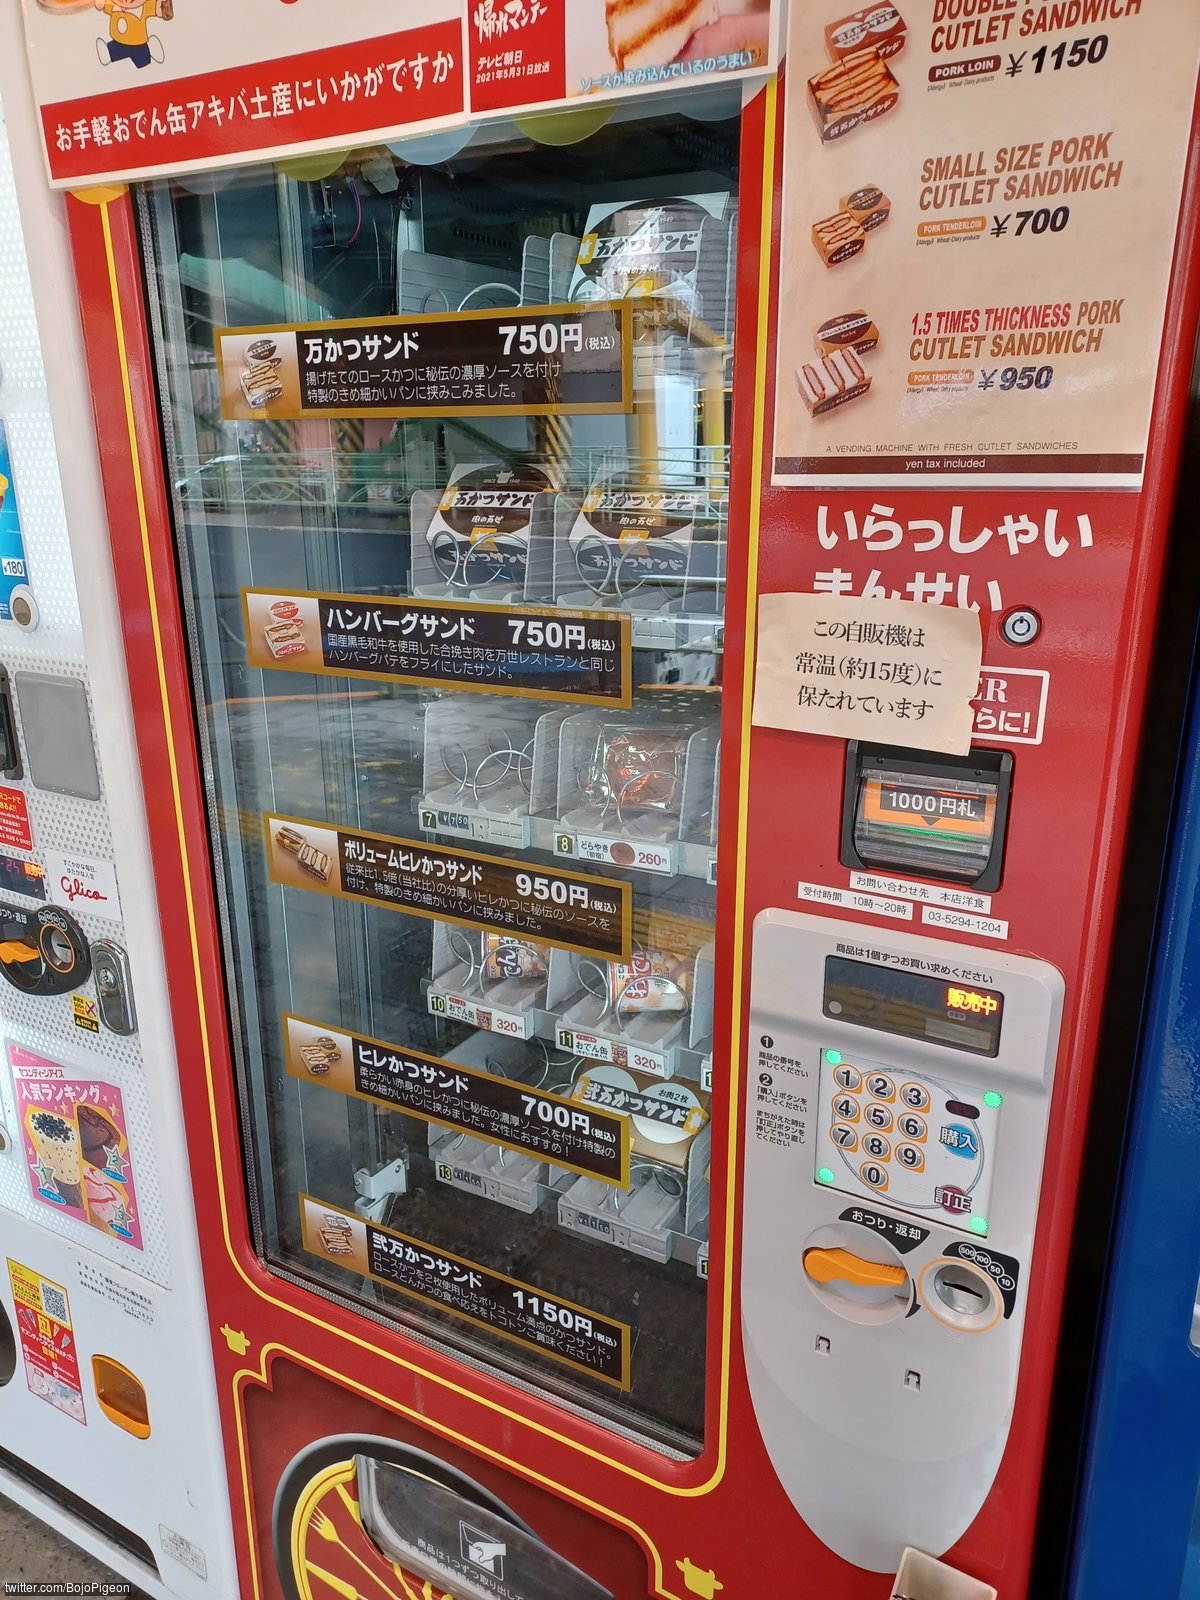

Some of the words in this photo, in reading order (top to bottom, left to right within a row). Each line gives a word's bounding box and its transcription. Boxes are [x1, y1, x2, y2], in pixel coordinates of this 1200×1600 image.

[931, 13, 1016, 53] CUTLET
[1019, 0, 1143, 37] SANDWICH
[477, 50, 523, 71] テレビ朝日
[936, 66, 965, 79] PORK
[968, 59, 995, 74] LOIN
[1005, 34, 1109, 78] ¥1150
[476, 62, 550, 83] 2021年5月31日放送
[56, 51, 454, 152] お手軽おでん缶アキバ土産にいかがですか
[920, 151, 987, 184] SMALL
[994, 141, 1042, 174] SIZE
[1047, 131, 1114, 165] PORK
[919, 178, 998, 211] CUTLET
[1004, 160, 1124, 201] SANDWICH
[923, 225, 941, 234] PORK
[942, 220, 982, 232] TENDERLOIN
[990, 206, 1070, 238] ¥700
[911, 312, 932, 337] 1.5
[935, 309, 979, 335] TIMES
[985, 302, 1072, 332] THICKNESS
[1077, 299, 1125, 326] PORK
[303, 331, 420, 364] 万かつサンド
[909, 336, 986, 362] CUTLET
[989, 328, 1104, 357] SANDWICH
[305, 362, 562, 387] 揚げたてのロースかつに秘伝の濃厚ソースを付け
[914, 374, 931, 382] PORK
[307, 382, 517, 403] 特製のきめ細かいパンに挟みこみました。
[836, 444, 872, 453] VENDING
[876, 443, 913, 453] MACHINE
[918, 443, 940, 452] WITH
[944, 442, 973, 452] FRESH
[977, 442, 1011, 451] CUTLET
[1016, 441, 1078, 451] SANDWICHES
[905, 459, 924, 471] yen
[926, 459, 941, 470] tax
[943, 457, 986, 470] included
[816, 502, 1094, 558] いらっしゃい
[327, 607, 475, 642] ハンバーグサンド
[813, 619, 926, 648] この自販機は
[328, 633, 615, 672] 国産黒毛和牛を使用した合挽き肉を万世レストランと同じ
[329, 650, 514, 681] ハンバーグパテをフライにしたサンド。
[795, 651, 943, 687] 常温(約15度)に
[796, 685, 935, 721] 保たれています
[889, 791, 976, 817] 1000円札
[561, 836, 570, 852] 8
[581, 840, 609, 853] どらやき
[344, 839, 483, 886] ボリュームヒレかつサンド
[60, 875, 108, 902] Glico
[803, 886, 842, 903] 受付時間
[856, 876, 929, 899] お問い合わせ先
[940, 892, 985, 909] 本店洋食
[928, 911, 1002, 934] 03-5294-1204
[836, 943, 993, 984] 商品は1個ずつお買い求めください
[431, 997, 444, 1012] 10
[946, 987, 998, 1016] 販売中
[560, 1032, 573, 1048] 11
[575, 1041, 608, 1055] おでん缶
[357, 1044, 469, 1093] ヒレかつサンド
[758, 1050, 802, 1069] 商品の番号を
[758, 1059, 809, 1078] 押してください
[842, 1069, 851, 1087] 1
[874, 1077, 888, 1097] 2
[21, 1081, 100, 1104] 人気ランキング
[757, 1094, 808, 1113] 押してください
[908, 1087, 922, 1106] 3
[359, 1066, 616, 1159] 柔らかい赤身のヒレかつに秘伝の濃厚ソースを付け特製の
[756, 1109, 806, 1129] まちがえた時は
[838, 1099, 851, 1116] 4
[871, 1108, 884, 1126] 5
[756, 1124, 806, 1144] 押してやり直し
[836, 1127, 850, 1146] 7
[904, 1117, 918, 1136] 6
[756, 1132, 791, 1148] てください
[869, 1137, 883, 1157] 8
[939, 1126, 979, 1155] 購入
[903, 1147, 917, 1166] 9
[440, 1166, 452, 1180] 13
[867, 1166, 880, 1186] 0
[934, 1186, 973, 1214] 訂正
[850, 1210, 922, 1242] おつり・返却
[372, 1231, 482, 1289] 弐万かつサンド
[959, 1245, 975, 1258] 500
[976, 1253, 989, 1265] 100
[990, 1264, 1001, 1274] 50
[1000, 1277, 1011, 1288] 10
